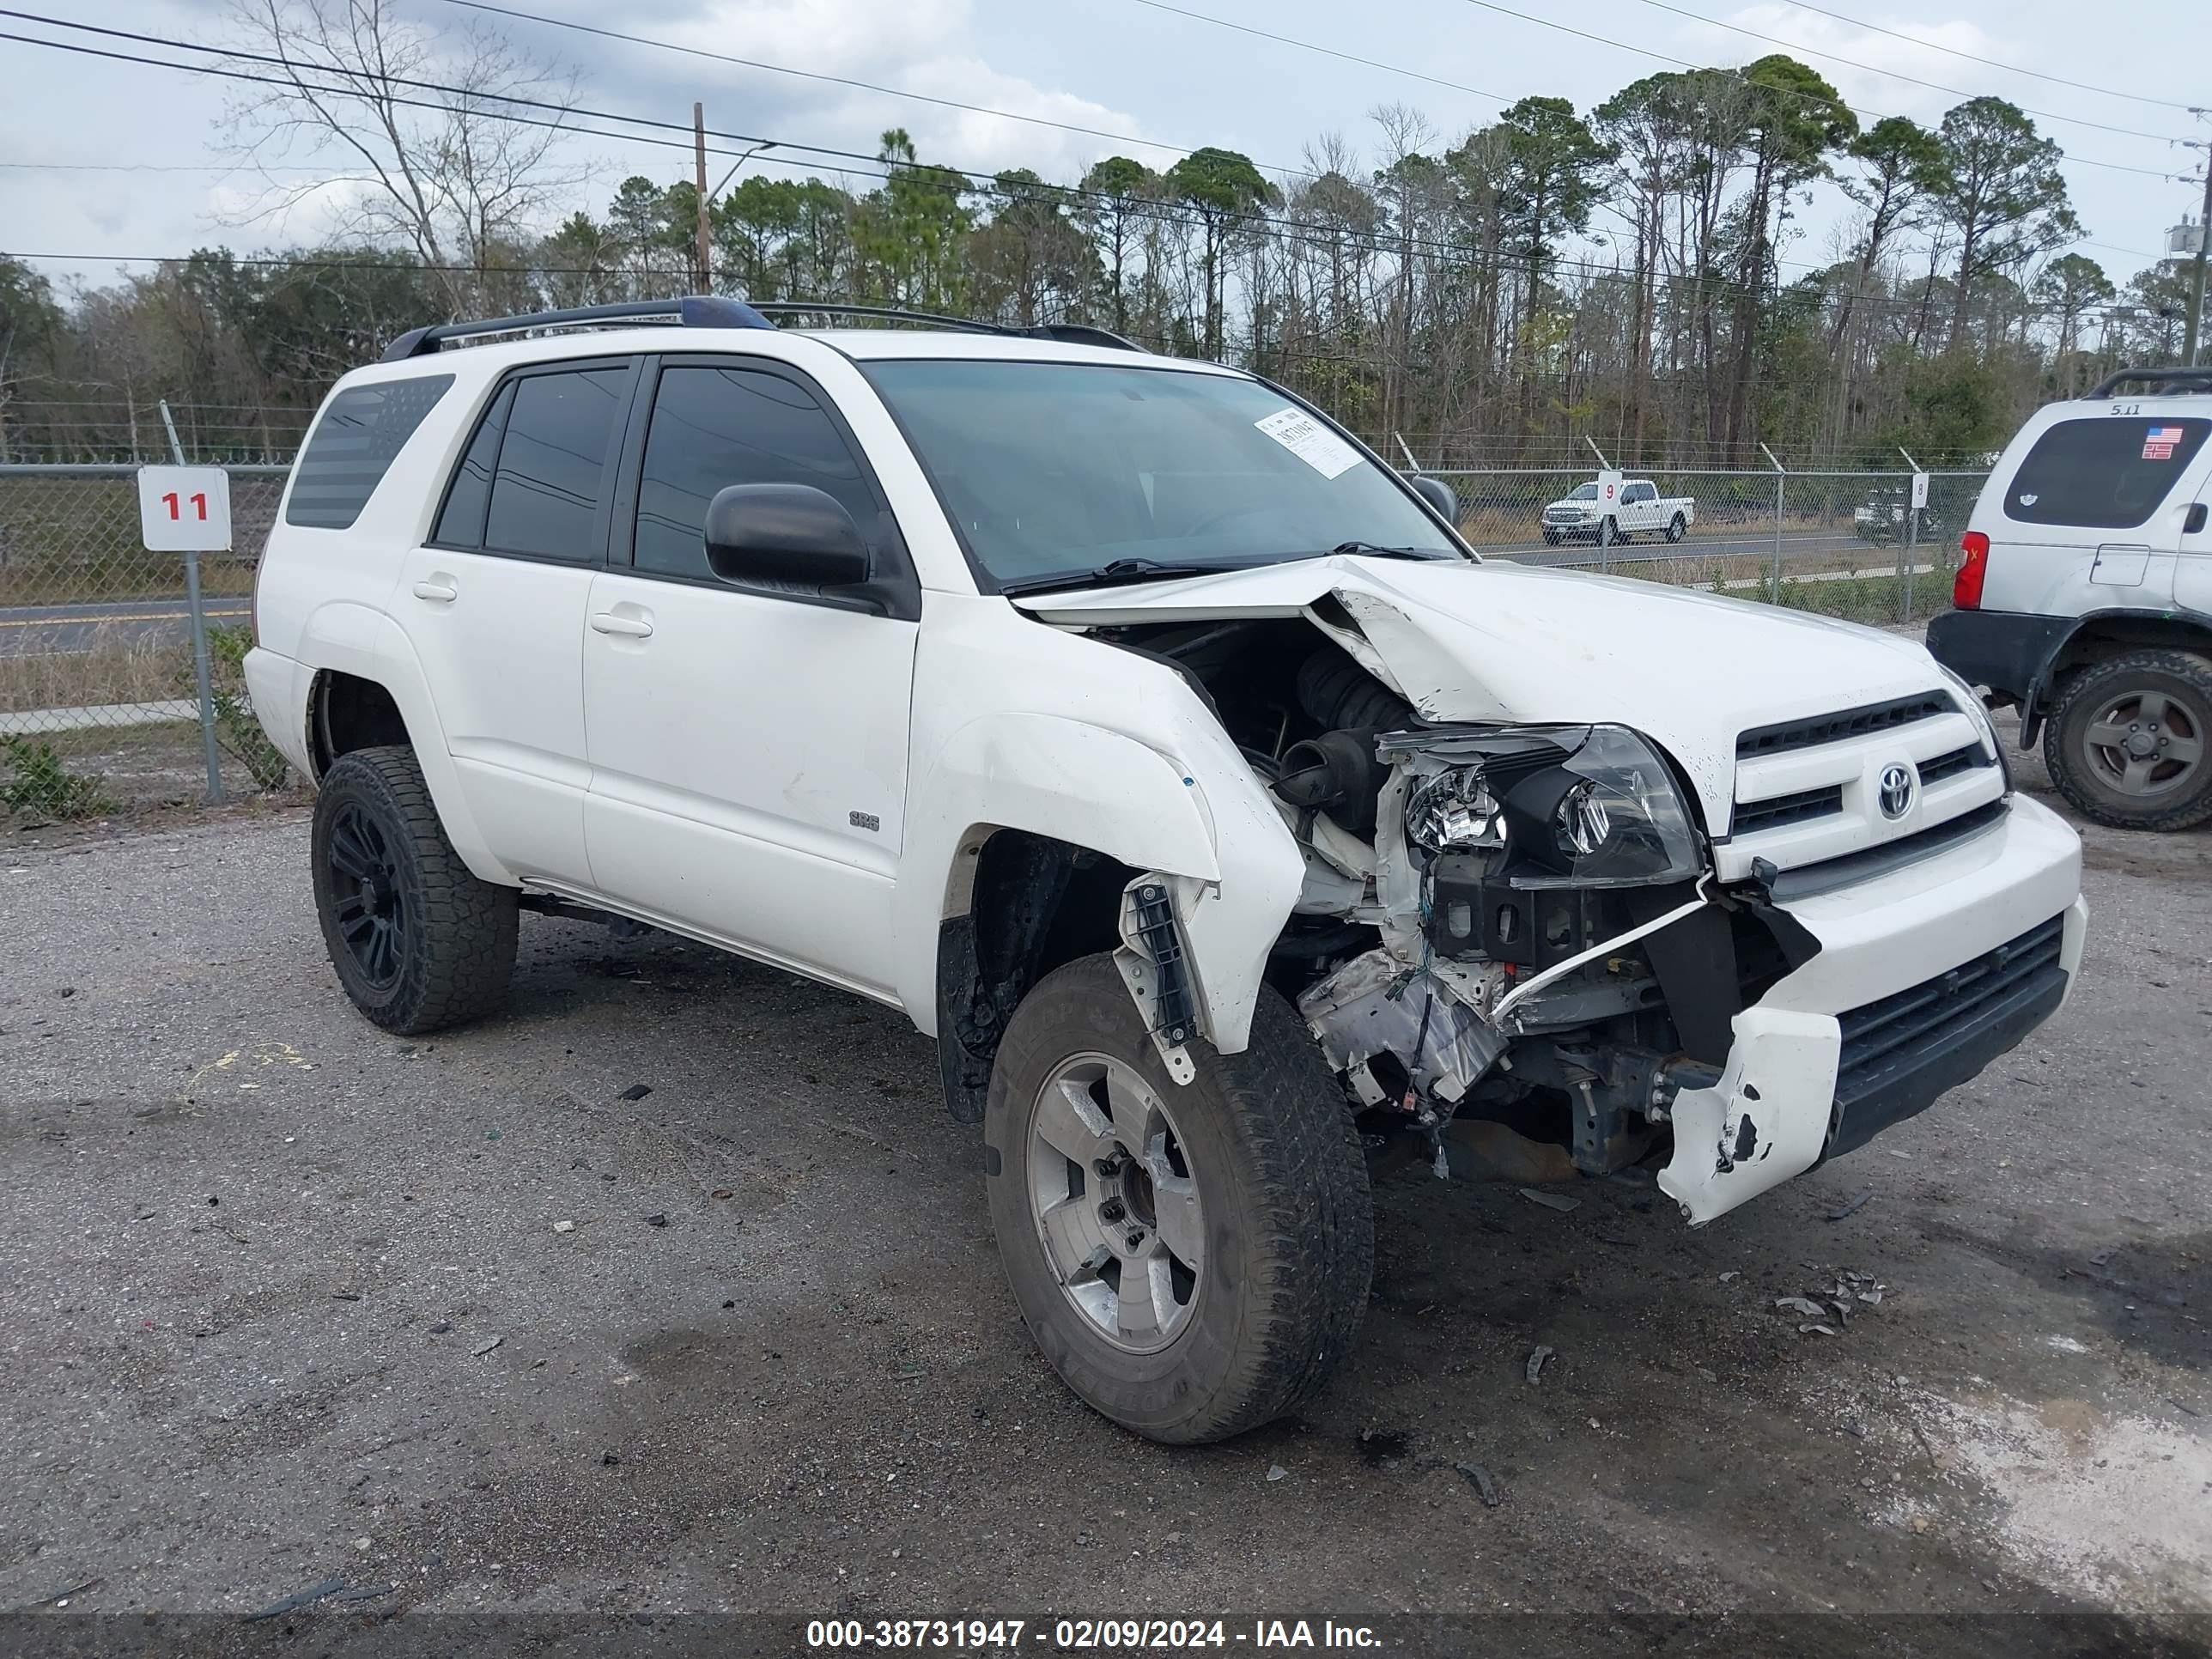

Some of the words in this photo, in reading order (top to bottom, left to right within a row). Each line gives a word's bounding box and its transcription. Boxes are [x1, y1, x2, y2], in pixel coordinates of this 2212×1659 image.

[2111, 404, 2141, 416] 5.11
[1607, 484, 1613, 499] 9
[1917, 483, 1923, 495] 8
[161, 493, 207, 520] 11
[849, 811, 879, 831] SR5
